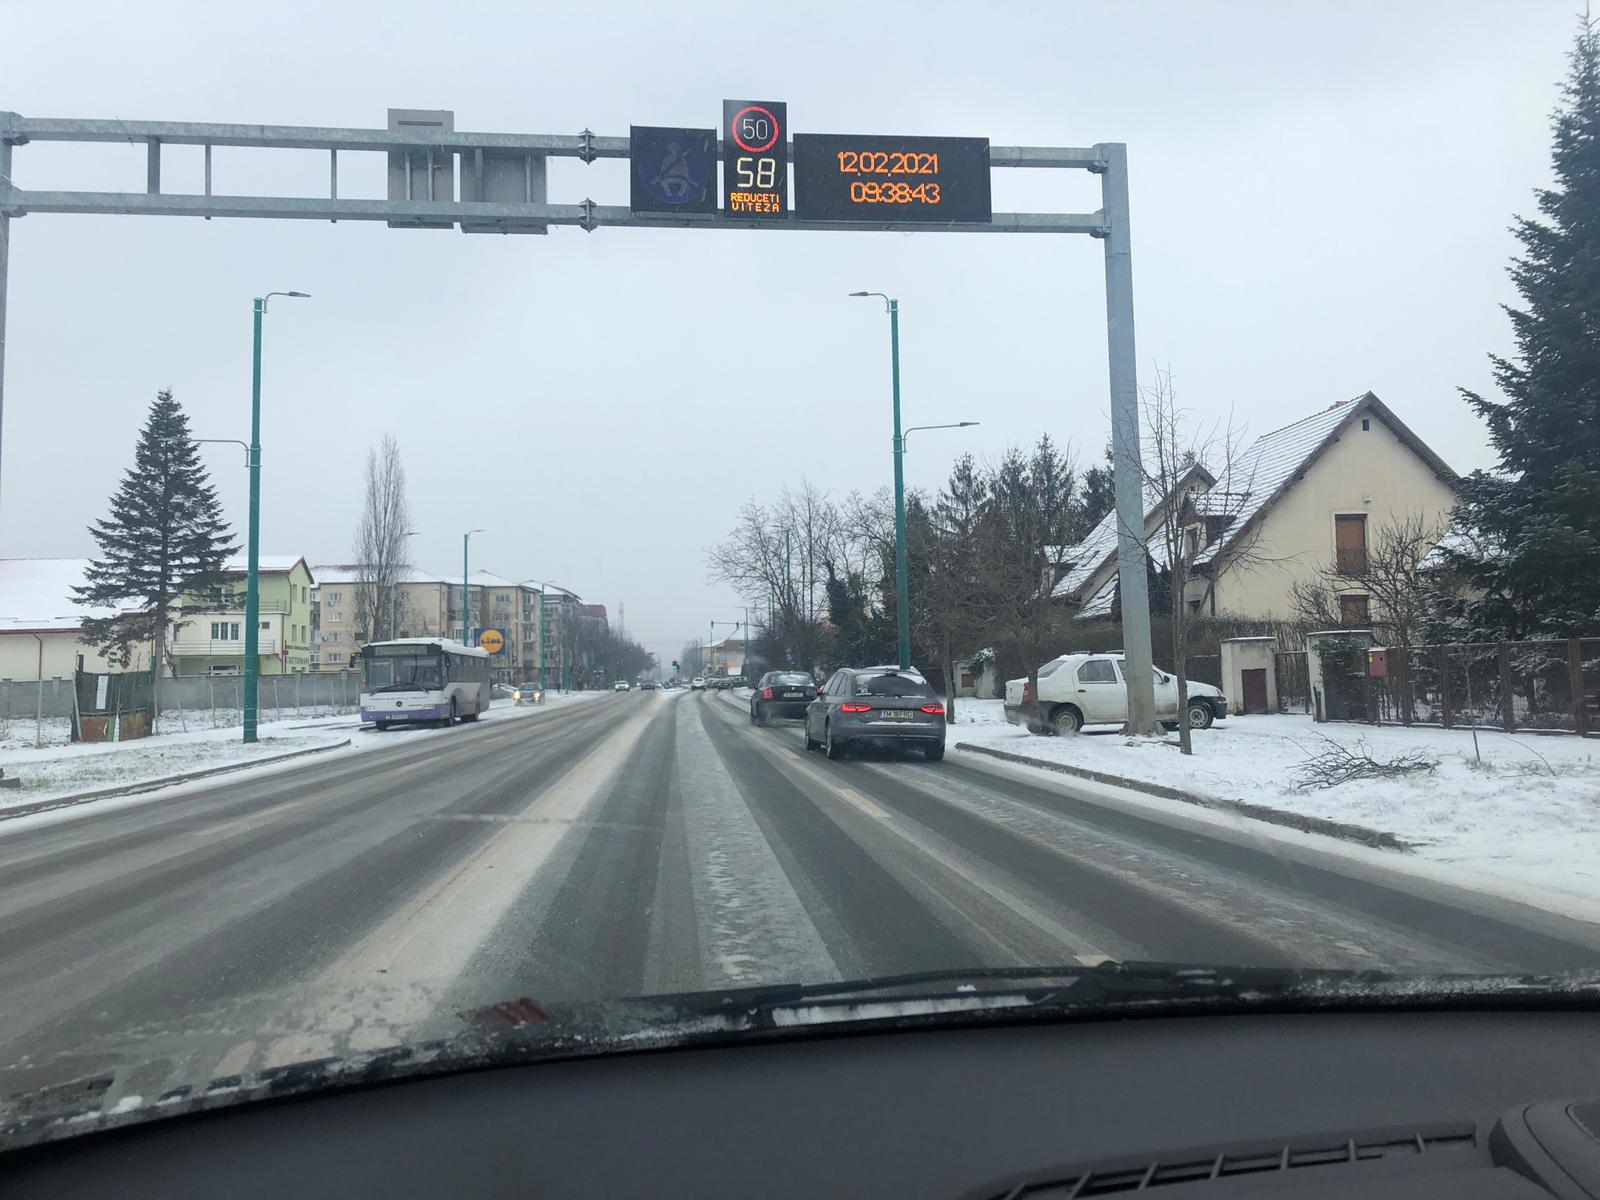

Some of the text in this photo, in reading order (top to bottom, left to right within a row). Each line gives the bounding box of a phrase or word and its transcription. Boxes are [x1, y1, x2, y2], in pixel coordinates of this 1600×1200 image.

[743, 118, 768, 140] 50
[737, 157, 776, 189] 58
[837, 151, 939, 177] 12.02.2021
[730, 192, 780, 203] REDUCETI
[850, 182, 942, 204] 09:38:43
[731, 202, 780, 213] VITEZA
